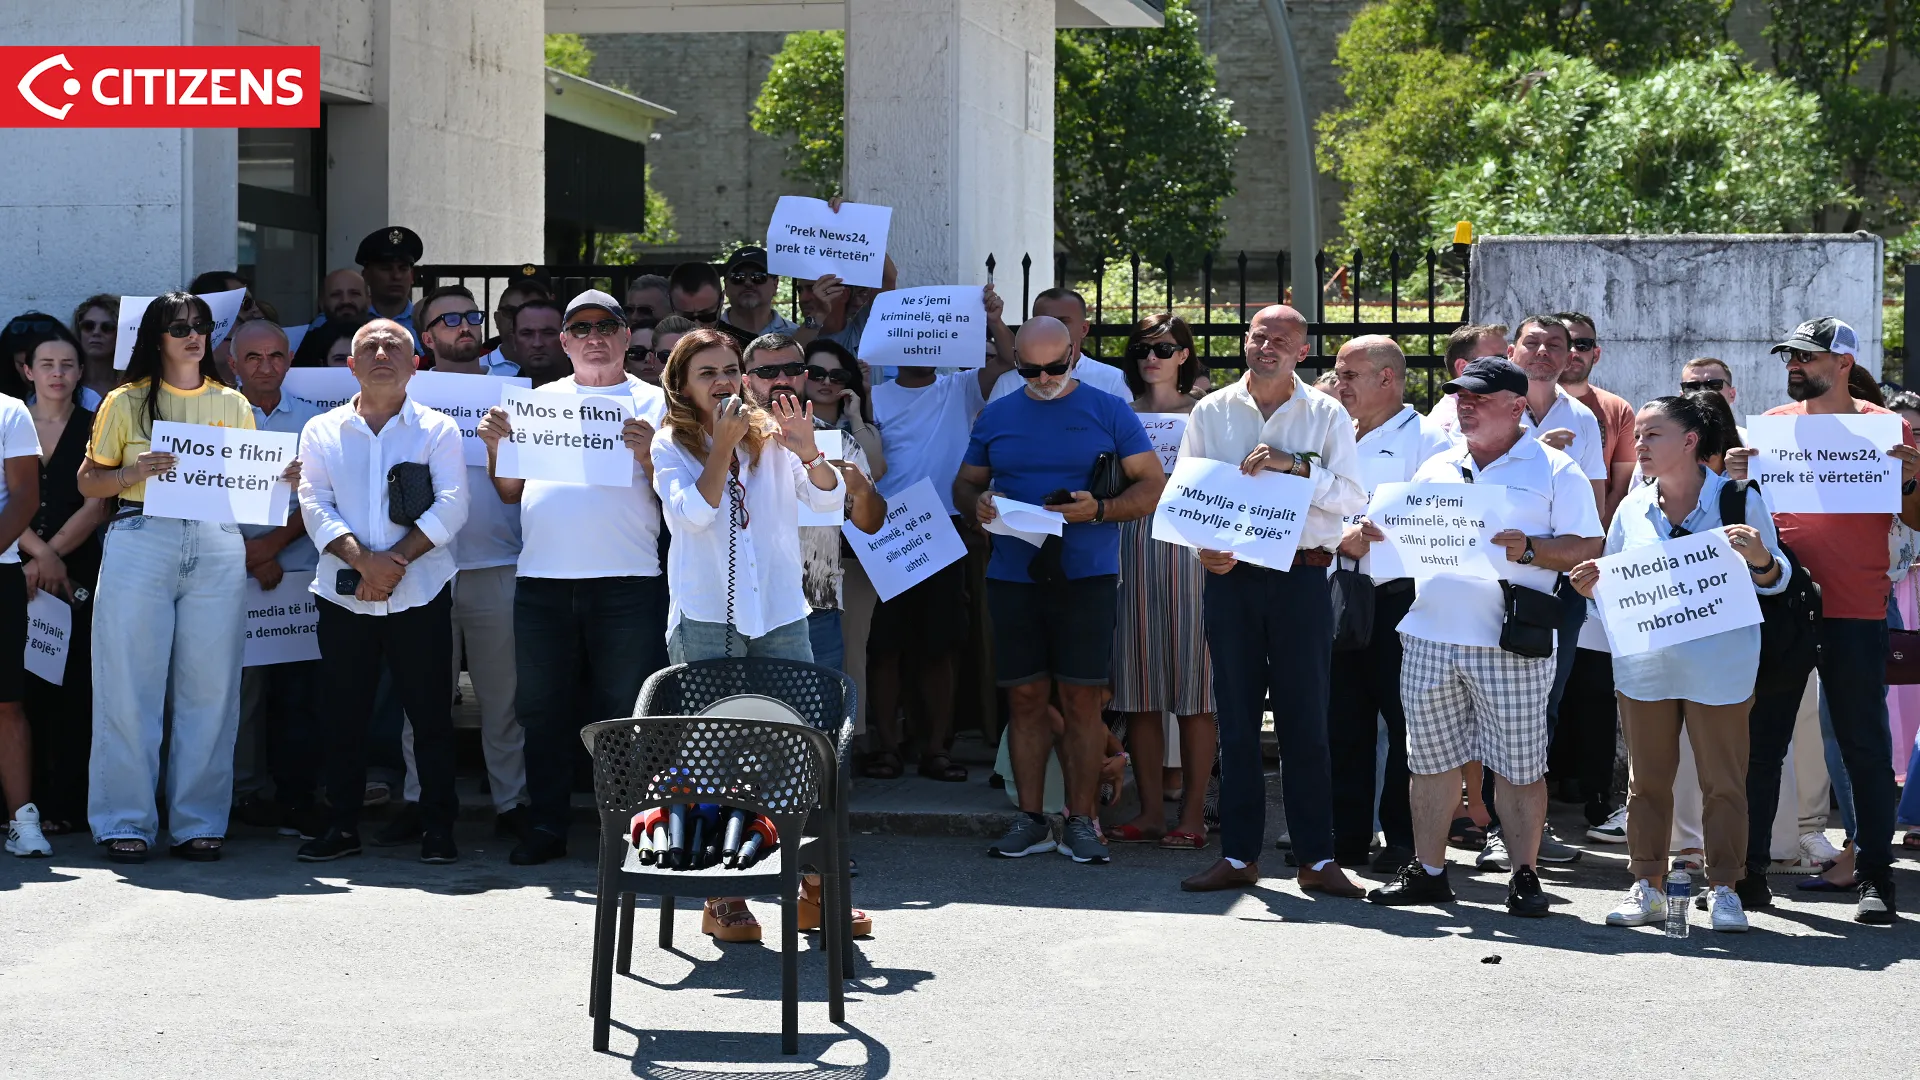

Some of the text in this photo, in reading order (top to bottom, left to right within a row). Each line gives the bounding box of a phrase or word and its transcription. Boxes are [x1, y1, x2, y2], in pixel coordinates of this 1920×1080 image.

[785, 223, 869, 246] "Prek News24,
[775, 243, 875, 262] prek të vërtetën"
[901, 297, 915, 305] Ne
[880, 312, 970, 324] kriminelë, që na
[887, 328, 914, 338] sillni
[917, 329, 948, 340] polici
[903, 345, 942, 355] ushtri!
[507, 399, 622, 423] "Mos e fikni
[1143, 420, 1178, 430] EWS
[508, 427, 624, 450] të vërtetën"
[1152, 443, 1181, 452] ZËR
[161, 435, 283, 463] "Mos e fikni
[1771, 449, 1881, 463] "Prek News24,
[183, 469, 279, 491] vërtetën"
[1761, 470, 1889, 485] prek të vërtetën"
[1177, 484, 1296, 522] "Mbyllja e sinjalit
[1406, 494, 1423, 506] Ne
[886, 502, 908, 524] jemi
[1384, 514, 1486, 530] kriminelë, që na
[867, 511, 932, 552] kriminelë, që na
[1179, 508, 1231, 529] mbyllje
[1234, 522, 1243, 532] e
[1245, 525, 1291, 540] gojës"
[885, 532, 932, 563] sillni polici e
[1400, 536, 1476, 549] sillni polici e
[904, 552, 930, 573] ushtri!
[1421, 554, 1459, 567] ushtri!
[1611, 544, 1720, 581] "Media nuk
[1618, 571, 1728, 610] mbyllet, por
[247, 602, 317, 619] media të lir
[1636, 597, 1724, 633] mbrohet"
[32, 618, 64, 641] sinjalit
[30, 638, 61, 656] gojës"
